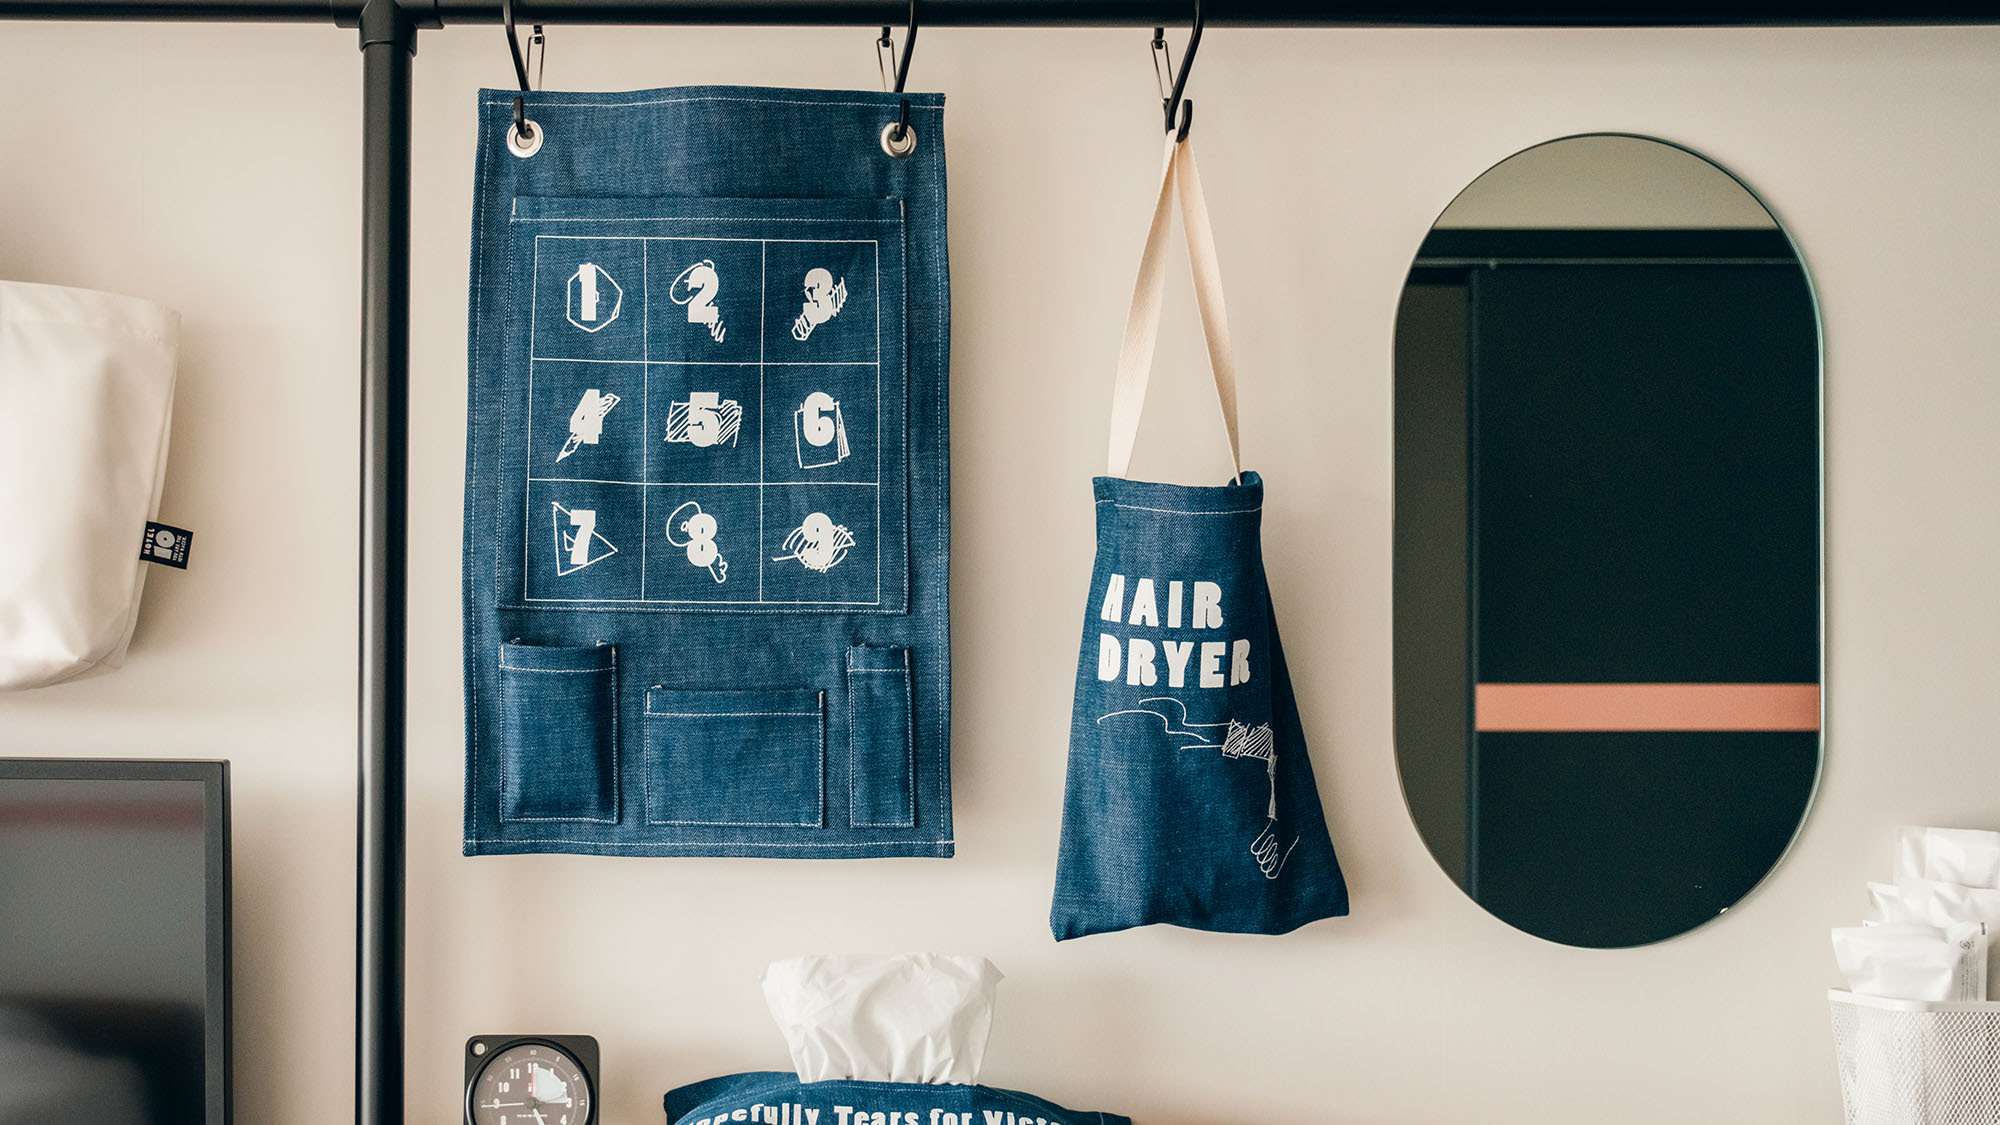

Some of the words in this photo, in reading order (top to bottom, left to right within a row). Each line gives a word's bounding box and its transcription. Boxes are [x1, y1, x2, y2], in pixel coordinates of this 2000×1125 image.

[579, 263, 597, 321] 1
[687, 266, 719, 323] 2
[803, 267, 834, 323] 3
[569, 389, 602, 444] 4
[688, 392, 720, 447] 5
[803, 391, 835, 446] 6
[143, 528, 155, 555] HOTEL
[570, 510, 596, 565] 7
[687, 513, 718, 567] 8
[802, 512, 834, 568] 9
[1101, 573, 1224, 629] HAIR
[1098, 633, 1250, 688] DRYER
[498, 1082, 510, 1093] 10
[510, 1068, 520, 1080] 11
[688, 1102, 820, 1125] opefully
[833, 1105, 919, 1125] Tears
[929, 1108, 973, 1125] for
